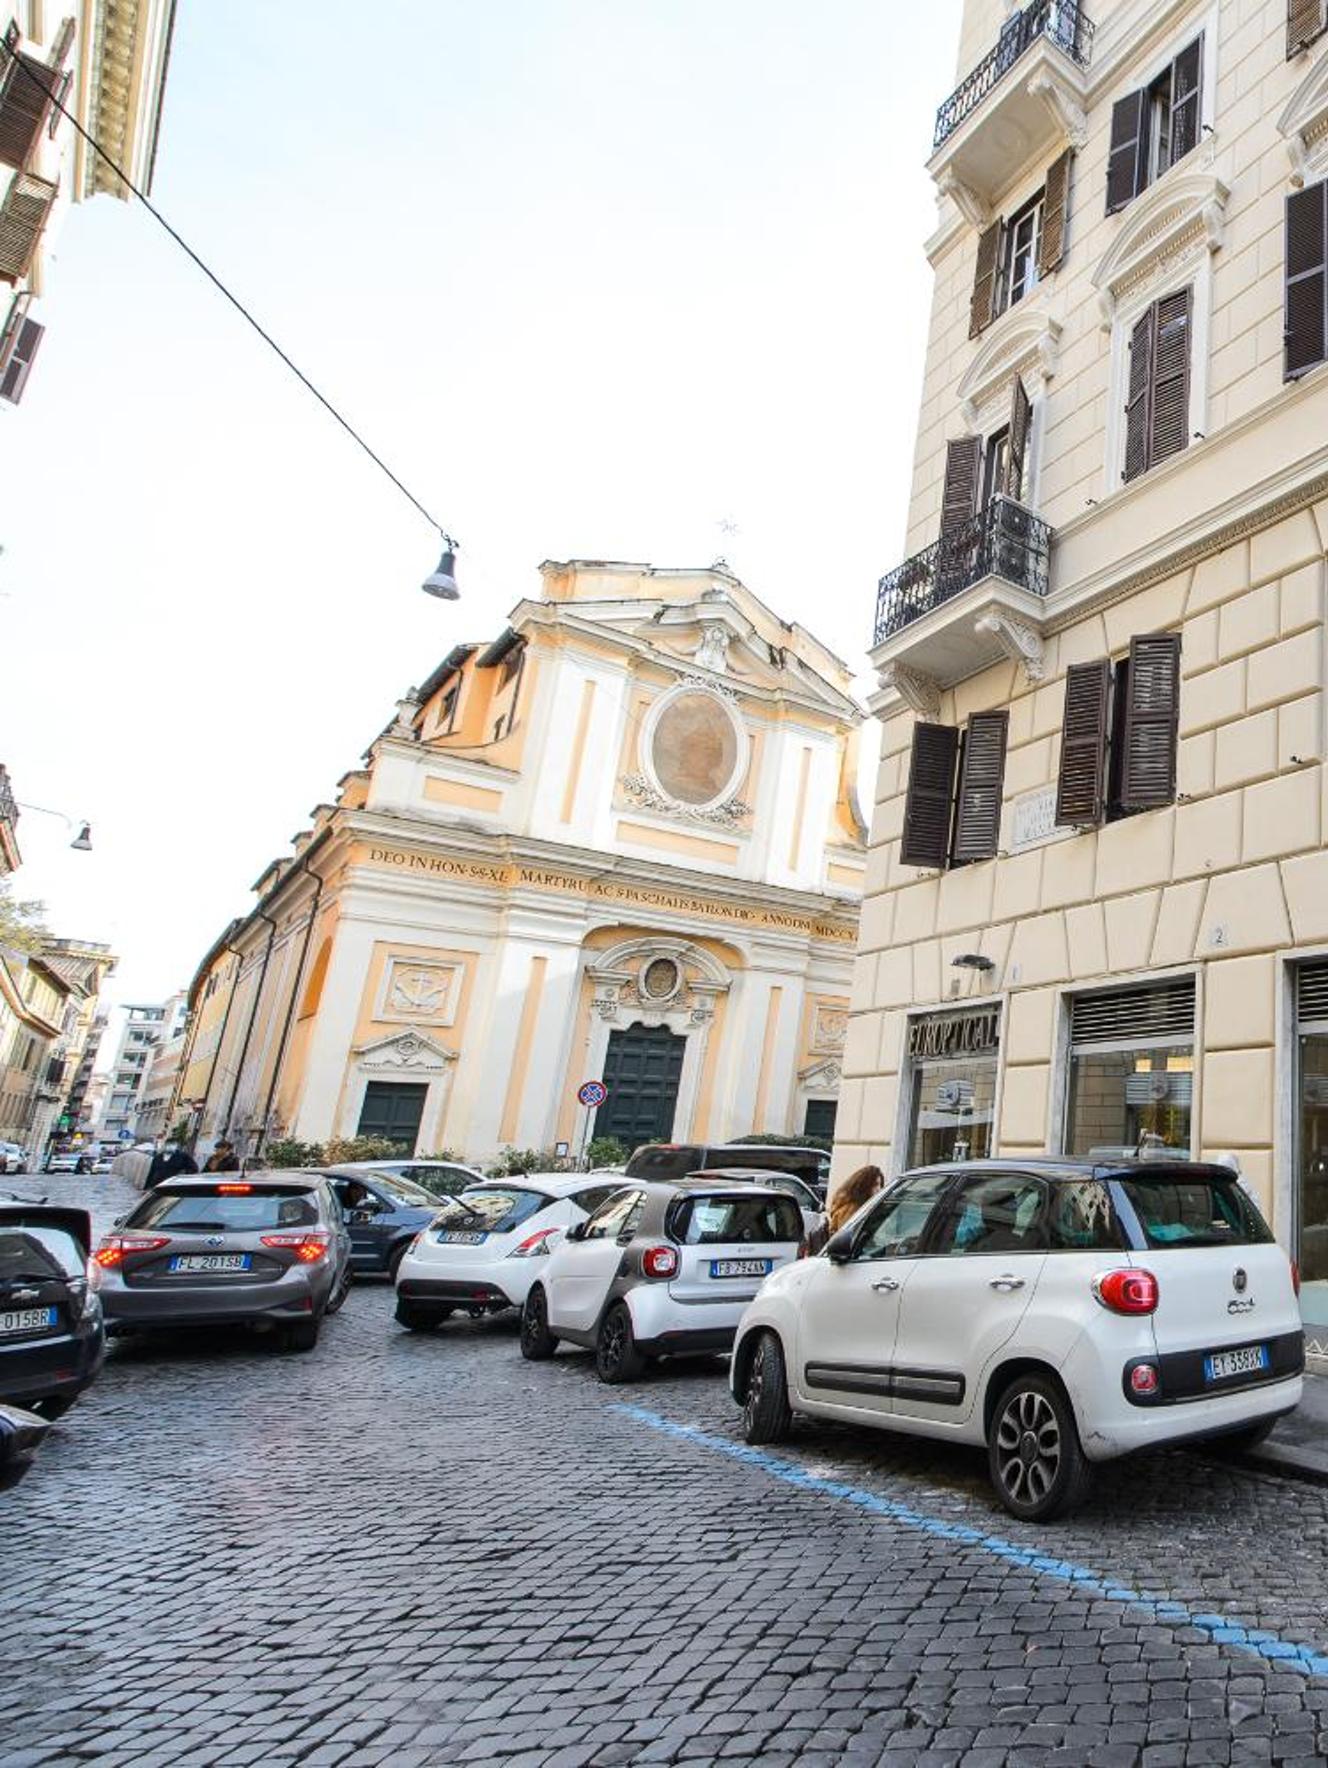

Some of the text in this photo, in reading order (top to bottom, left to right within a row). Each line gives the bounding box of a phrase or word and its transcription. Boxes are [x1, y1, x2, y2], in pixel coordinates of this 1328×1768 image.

[370, 849, 405, 865] DEO
[409, 854, 427, 869] IN
[1215, 926, 1224, 944] 2
[908, 1014, 995, 1056] EUROPTICAL
